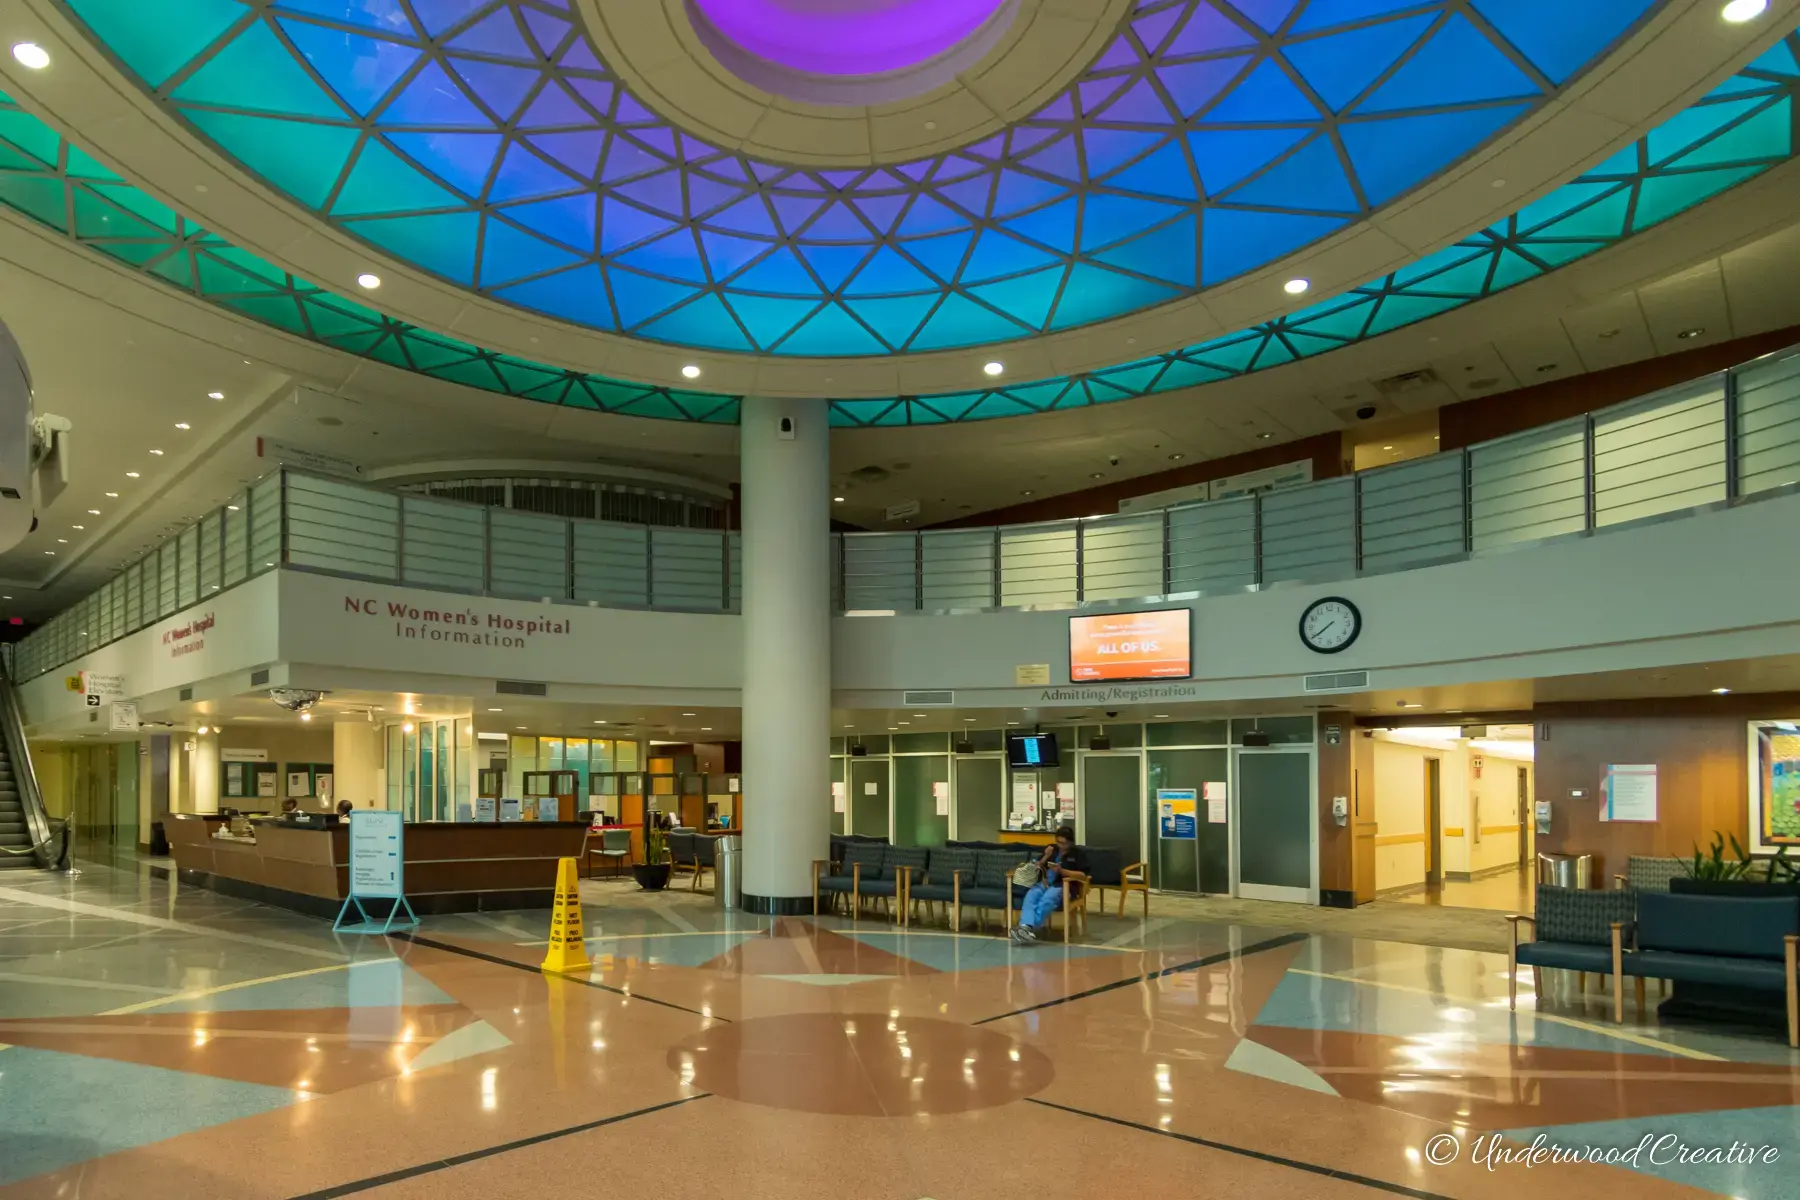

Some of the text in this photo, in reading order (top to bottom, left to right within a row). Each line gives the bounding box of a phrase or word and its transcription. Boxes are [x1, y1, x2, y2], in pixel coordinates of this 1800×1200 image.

[345, 597, 570, 635] NC Women's Hospital
[397, 622, 525, 649] Information
[1097, 643, 1119, 655] ALL
[1121, 641, 1138, 654] OF
[1041, 685, 1196, 703] Admitting/Registration
